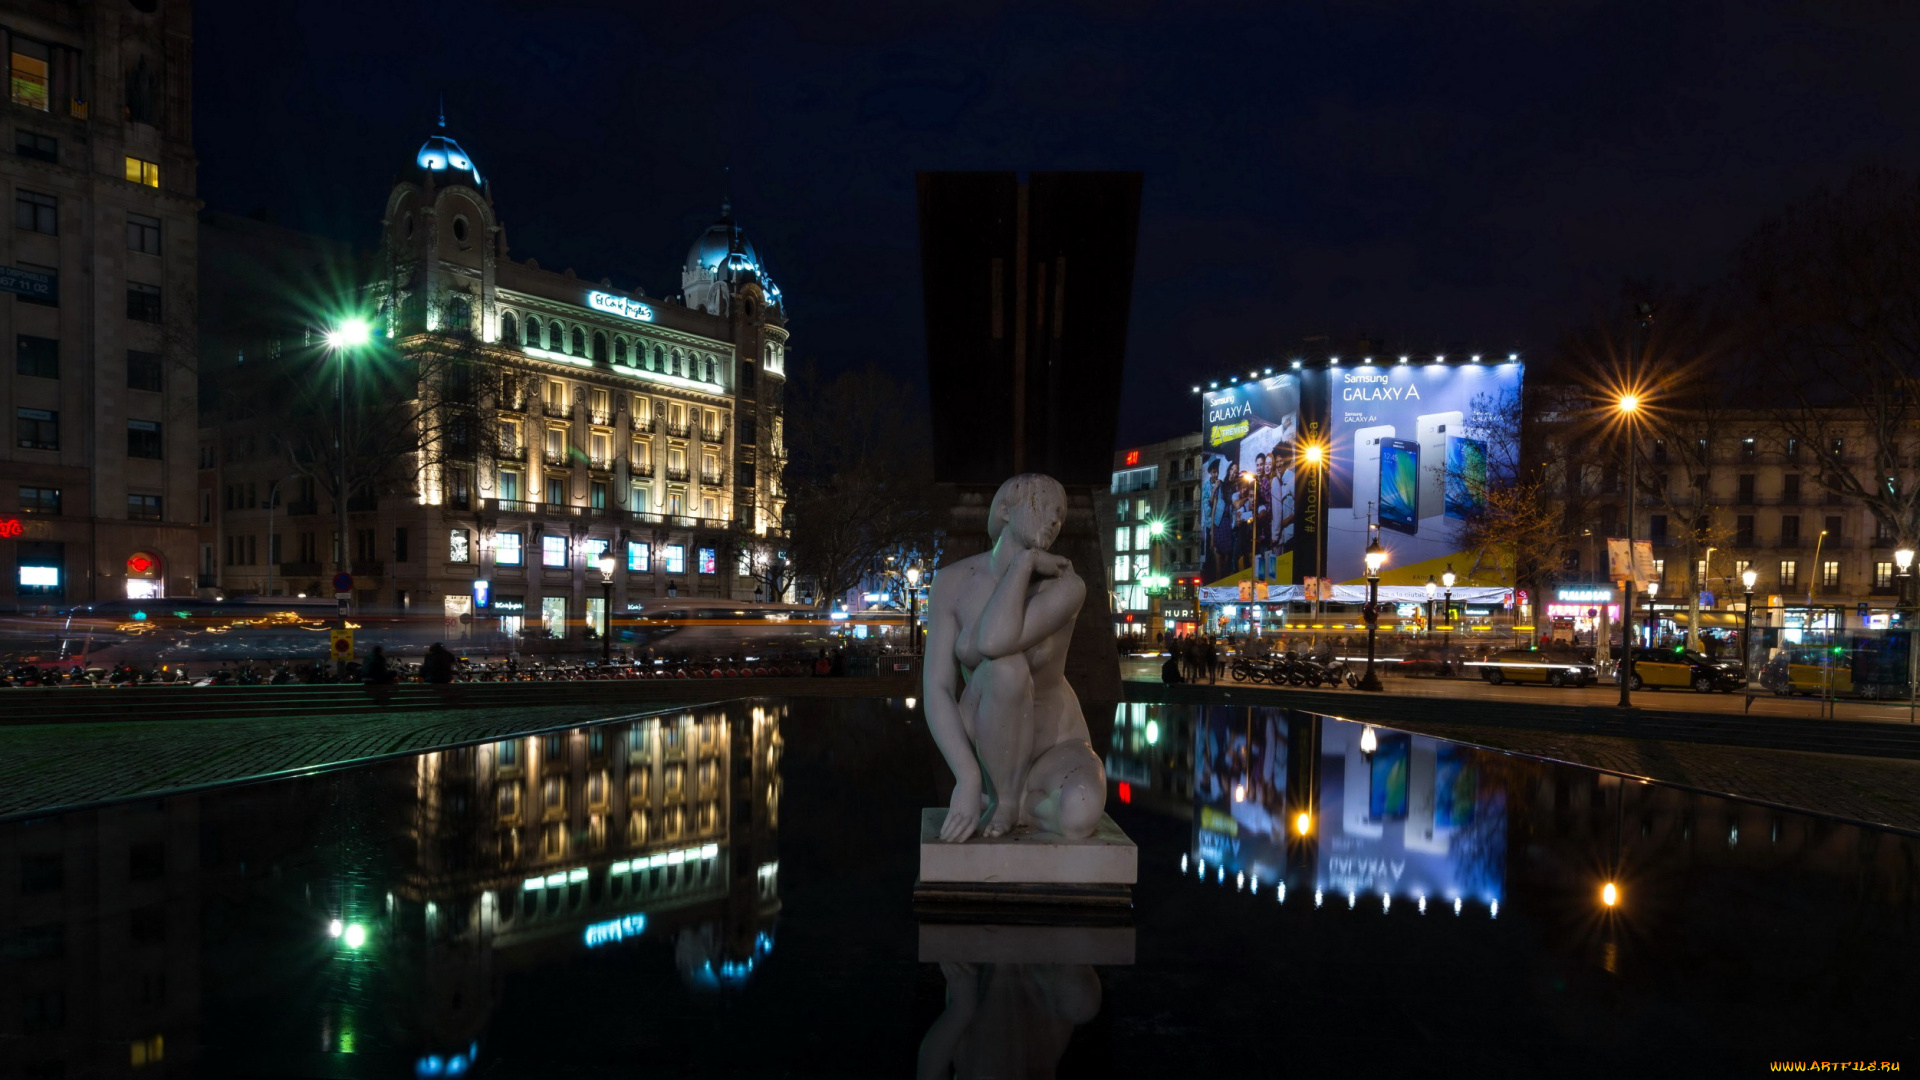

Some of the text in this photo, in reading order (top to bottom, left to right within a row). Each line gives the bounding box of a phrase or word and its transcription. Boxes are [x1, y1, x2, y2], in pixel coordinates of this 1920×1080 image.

[33, 283, 48, 294] 02
[1344, 373, 1389, 385] Samsung
[1343, 383, 1420, 401] GALAXY A
[1210, 395, 1235, 407] Samsung
[1209, 400, 1252, 423] GALAXY A
